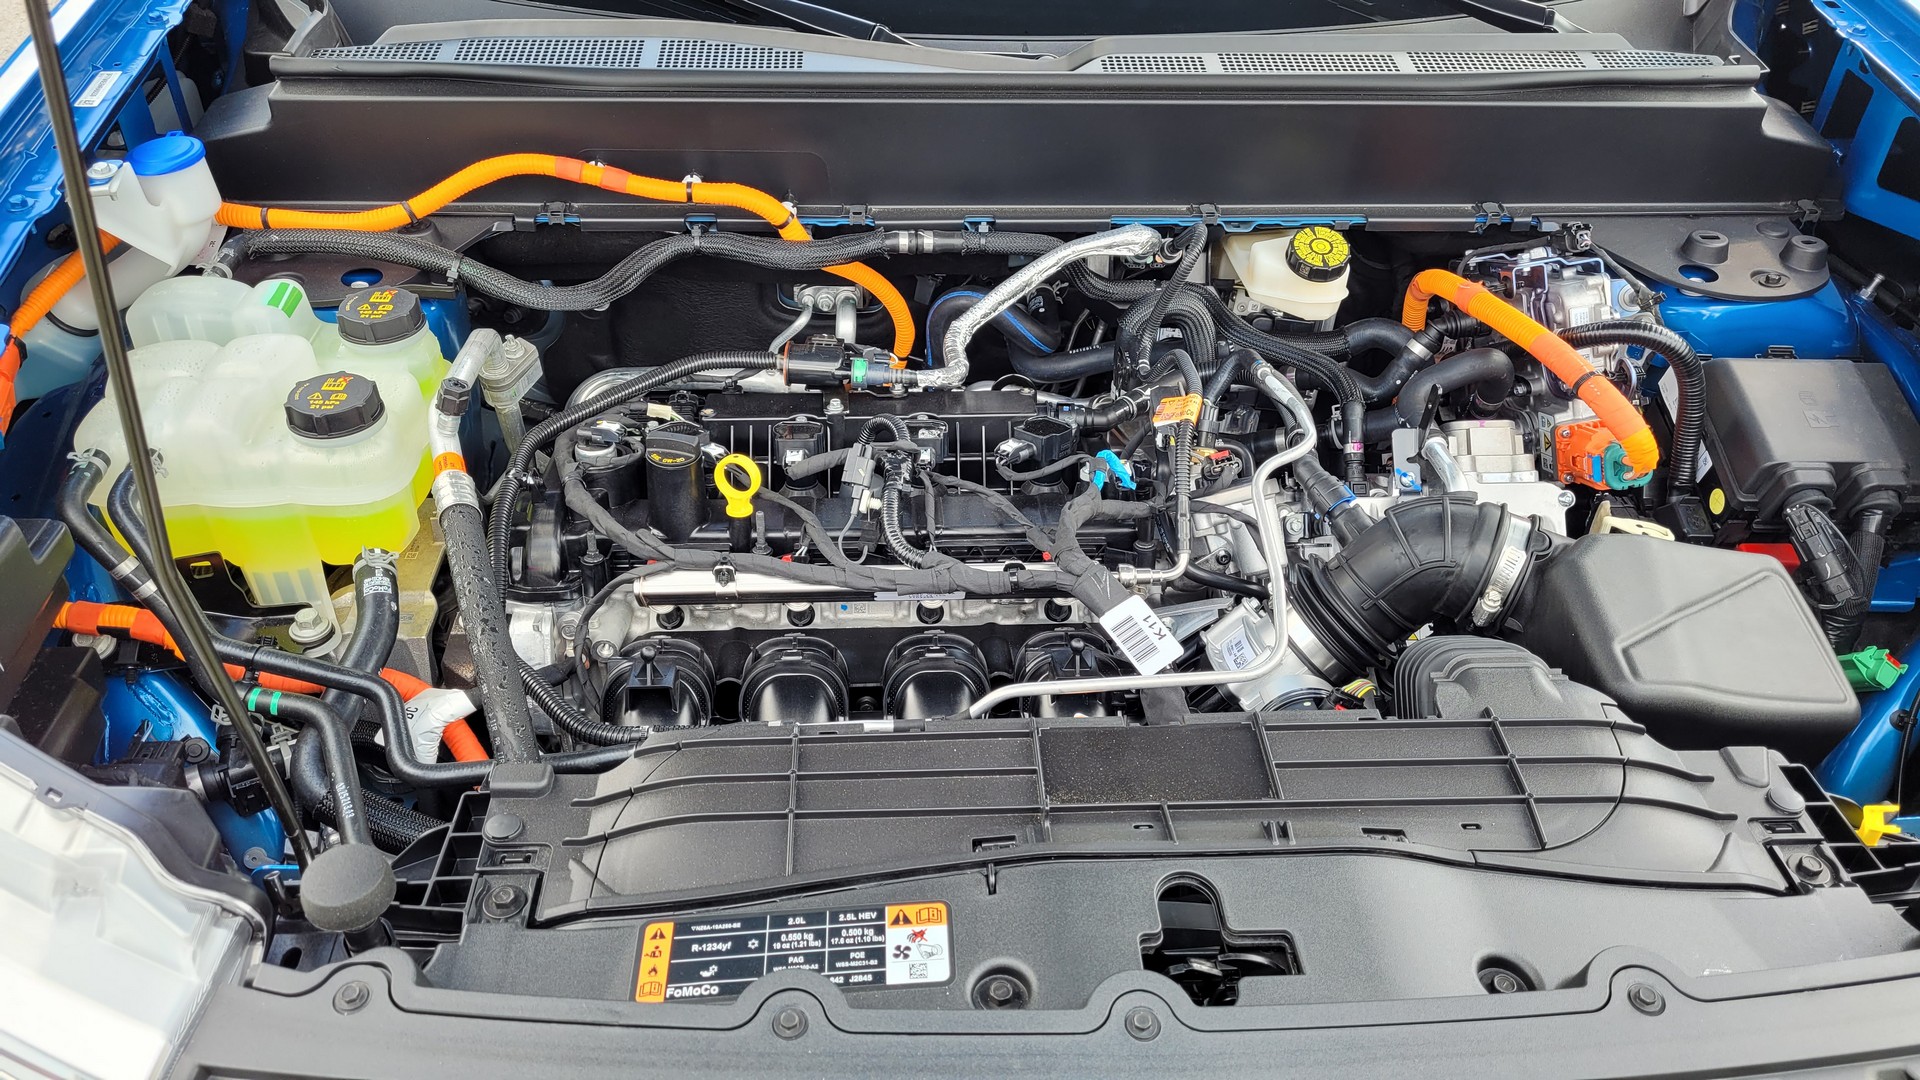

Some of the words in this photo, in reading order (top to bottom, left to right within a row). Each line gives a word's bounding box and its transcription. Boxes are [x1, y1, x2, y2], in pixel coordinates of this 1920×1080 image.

[1142, 615, 1167, 641] K11
[787, 917, 806, 925] 2.0L
[838, 913, 857, 922] 2.5L
[858, 911, 877, 920] HEV
[803, 932, 814, 941] kg
[863, 928, 874, 936] kg
[691, 941, 732, 953] R-1234yf
[788, 956, 805, 964] PAG
[849, 951, 866, 960] POE
[666, 985, 719, 998] FoMoCo
